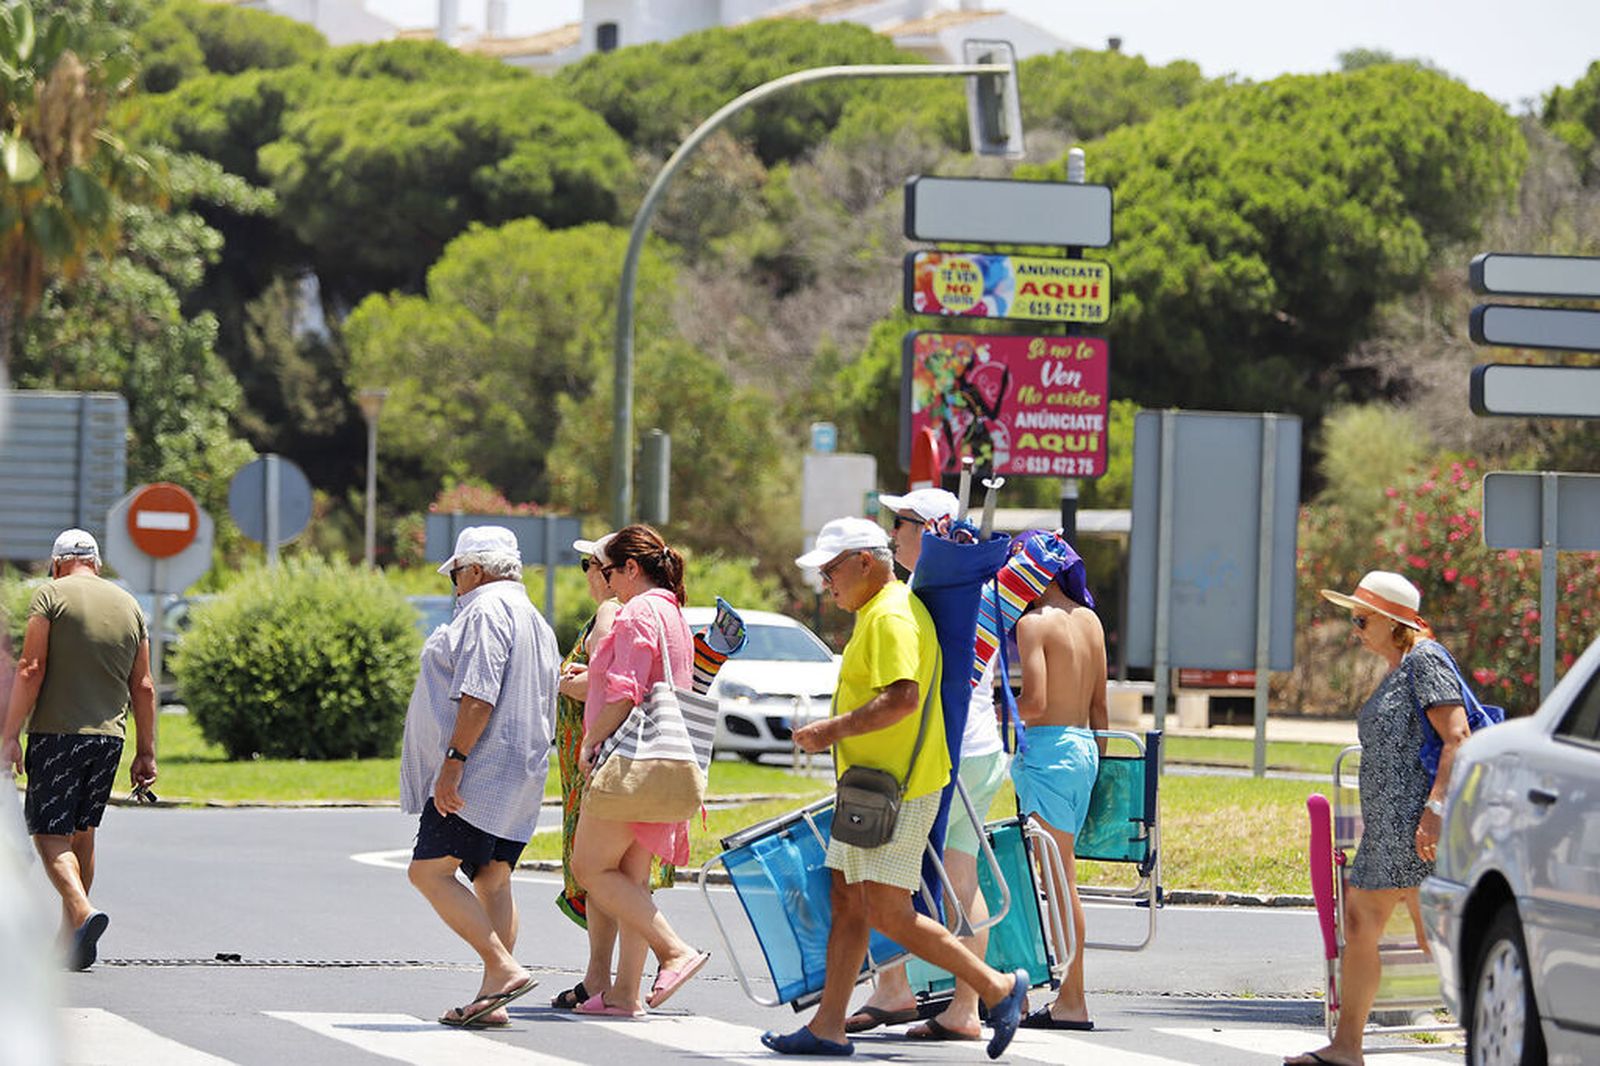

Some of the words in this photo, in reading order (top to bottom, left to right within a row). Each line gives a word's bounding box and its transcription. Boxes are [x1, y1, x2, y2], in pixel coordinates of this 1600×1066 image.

[946, 284, 971, 294] NO
[1050, 345, 1073, 359] no
[1041, 360, 1082, 388] Ven
[1017, 385, 1043, 406] No
[1047, 389, 1101, 408] existes
[1015, 409, 1104, 431] ANÚNCIATE
[1017, 432, 1099, 453] AQUÍ
[1026, 455, 1051, 473] 619
[1052, 456, 1076, 474] 472
